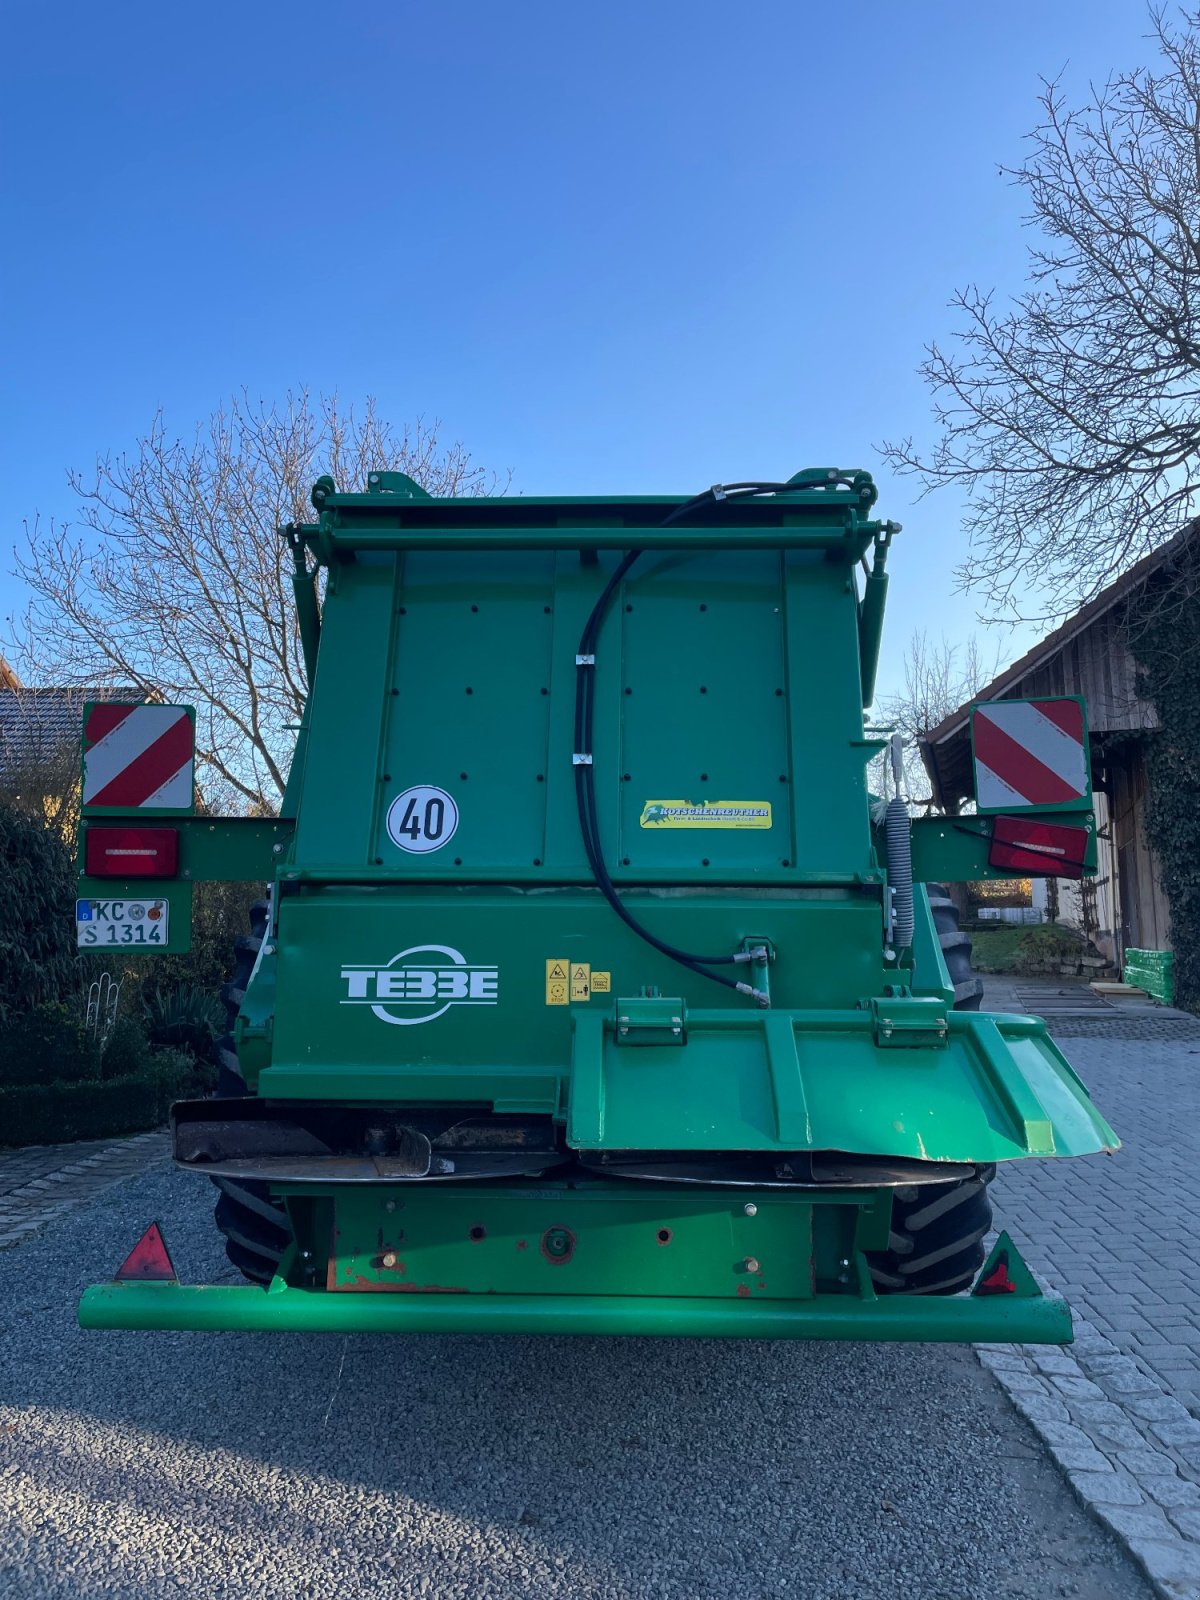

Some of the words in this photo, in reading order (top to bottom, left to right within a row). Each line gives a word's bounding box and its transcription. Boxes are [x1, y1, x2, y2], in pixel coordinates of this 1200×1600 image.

[399, 797, 445, 841] 40
[660, 808, 769, 816] KOTSCHENREUTHER
[97, 902, 125, 921] KC
[84, 924, 98, 944] S
[107, 924, 161, 944] 1314
[341, 971, 498, 998] TEBBE
